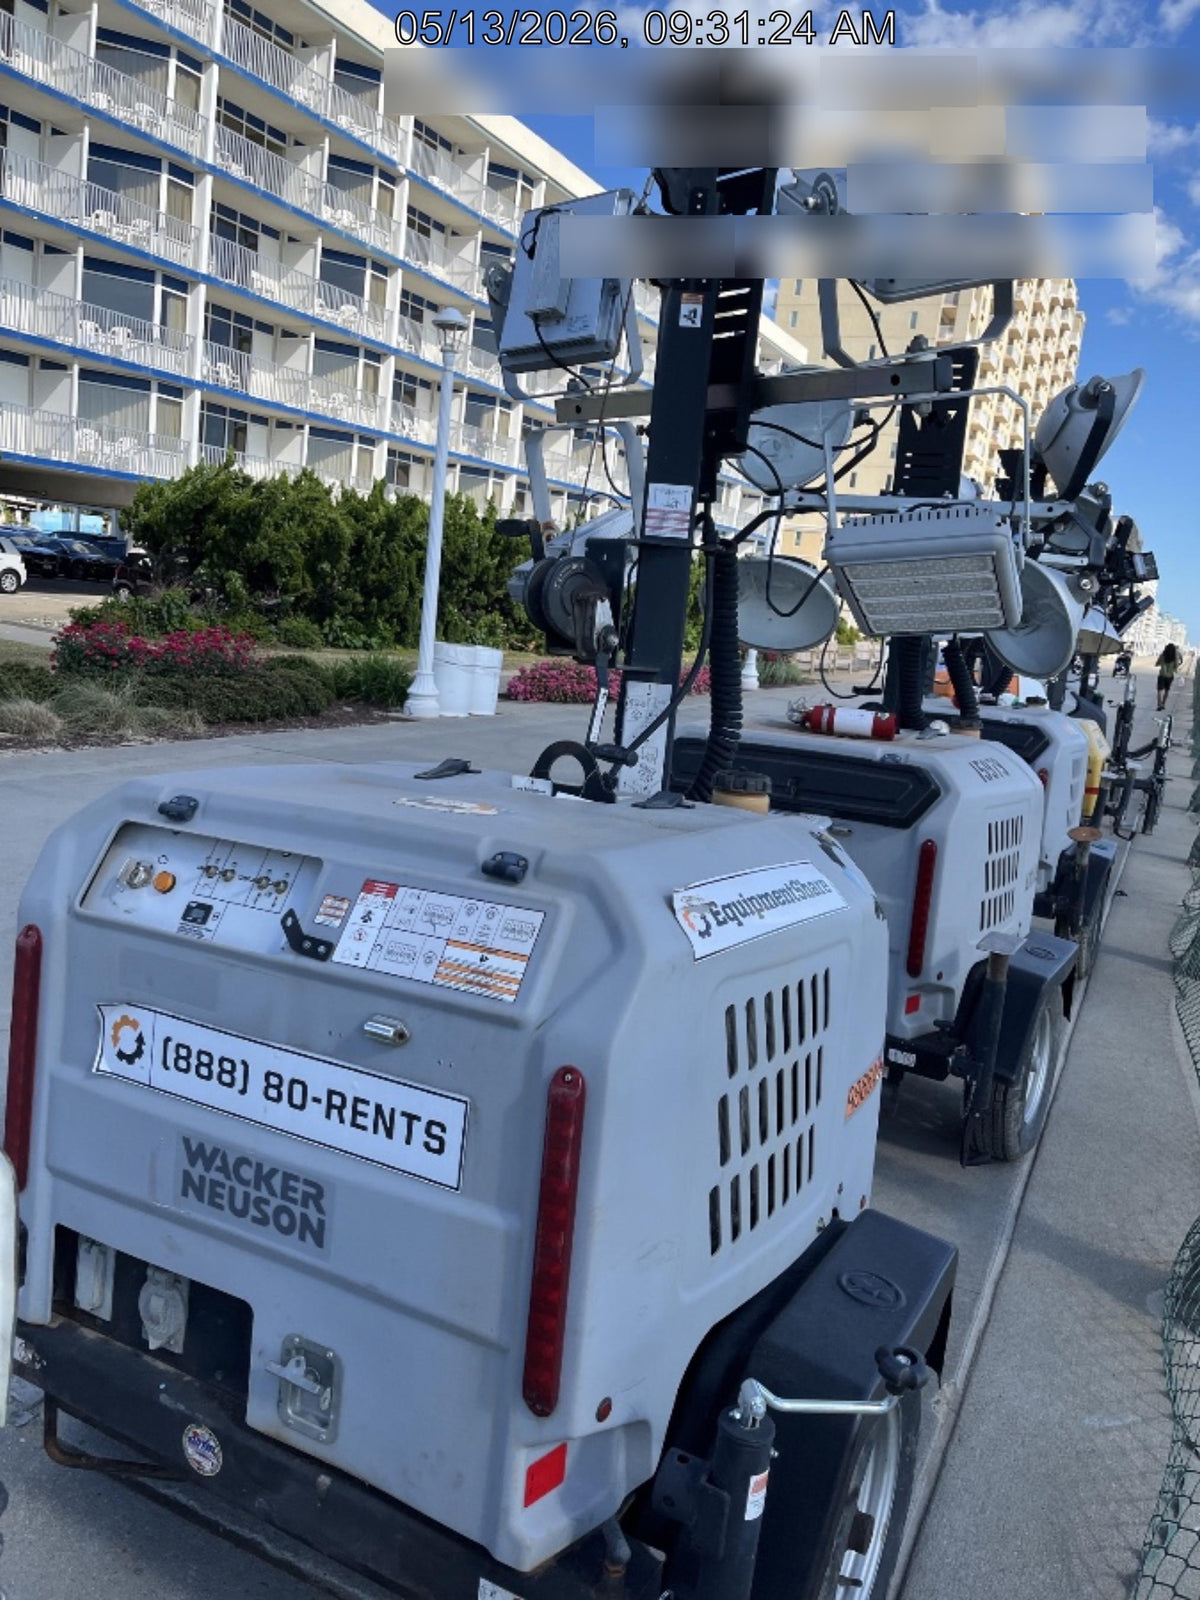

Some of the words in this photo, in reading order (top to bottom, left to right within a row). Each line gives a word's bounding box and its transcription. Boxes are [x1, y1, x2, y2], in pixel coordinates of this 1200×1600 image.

[709, 879, 832, 927] EquipmentShare
[163, 1036, 249, 1095] (888)
[264, 1071, 446, 1155] 80-RENTS
[182, 1172, 325, 1249] NEUSON
[183, 1137, 325, 1215] WACKER
